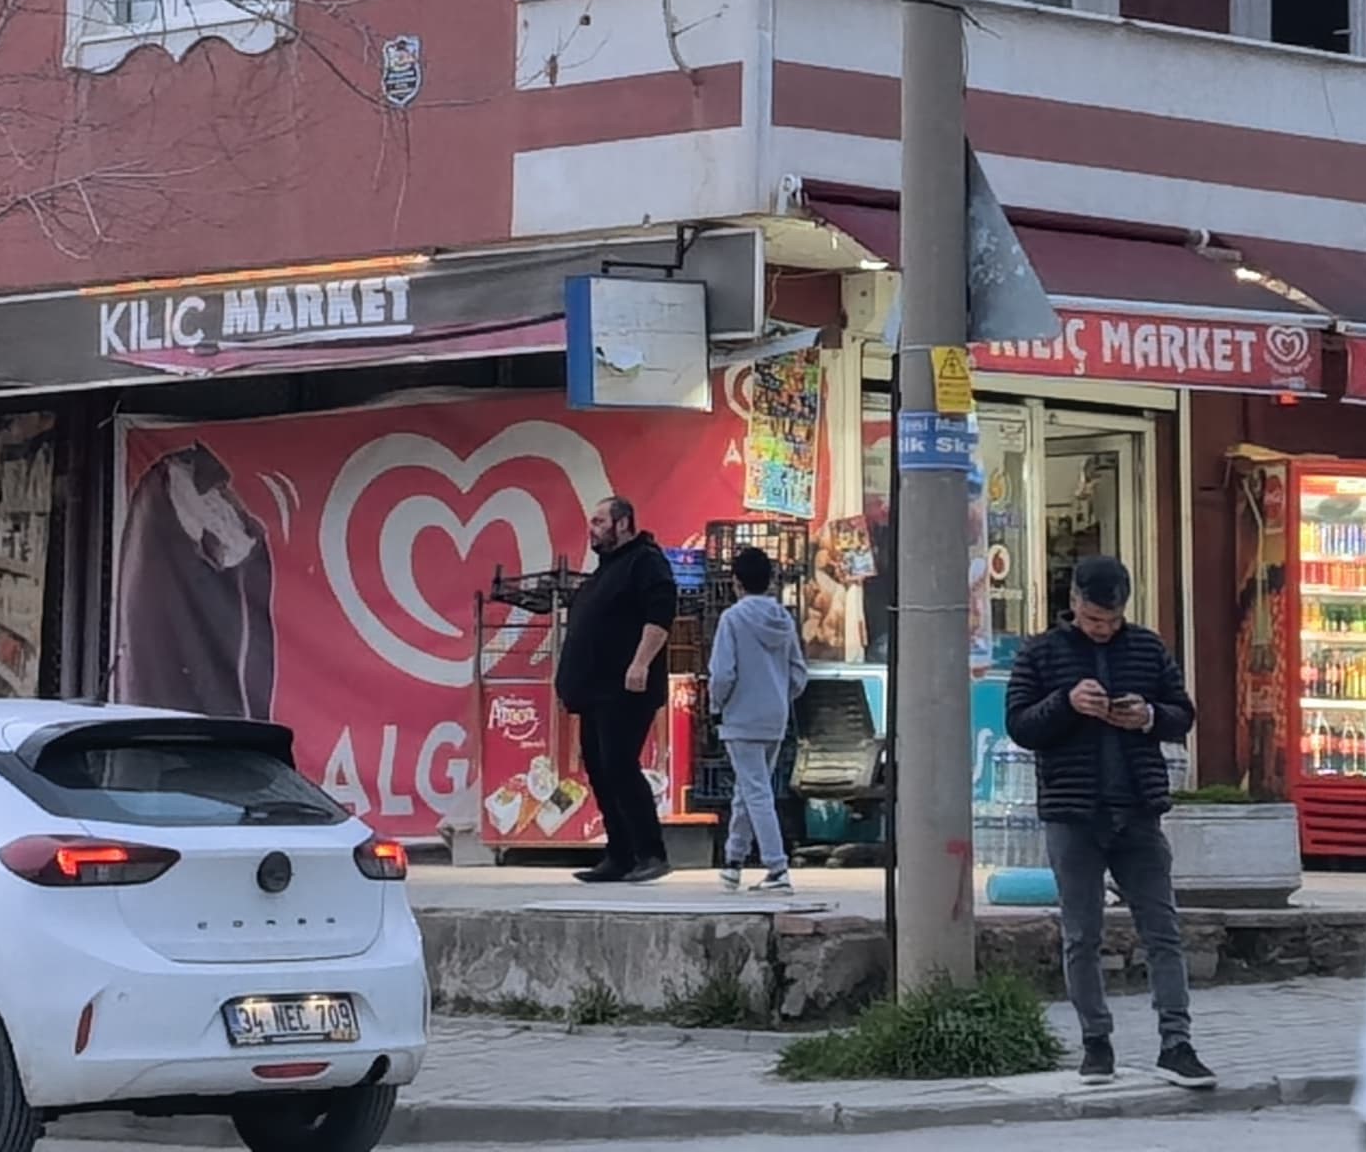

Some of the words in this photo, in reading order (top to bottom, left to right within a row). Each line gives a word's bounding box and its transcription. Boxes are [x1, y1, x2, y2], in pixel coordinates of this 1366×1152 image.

[222, 275, 410, 335] MARKET
[1101, 320, 1257, 374] MARKET
[321, 720, 470, 817] ALG
[238, 1006, 265, 1034] 34
[271, 1005, 311, 1032] NEC
[314, 1002, 353, 1031] 709
